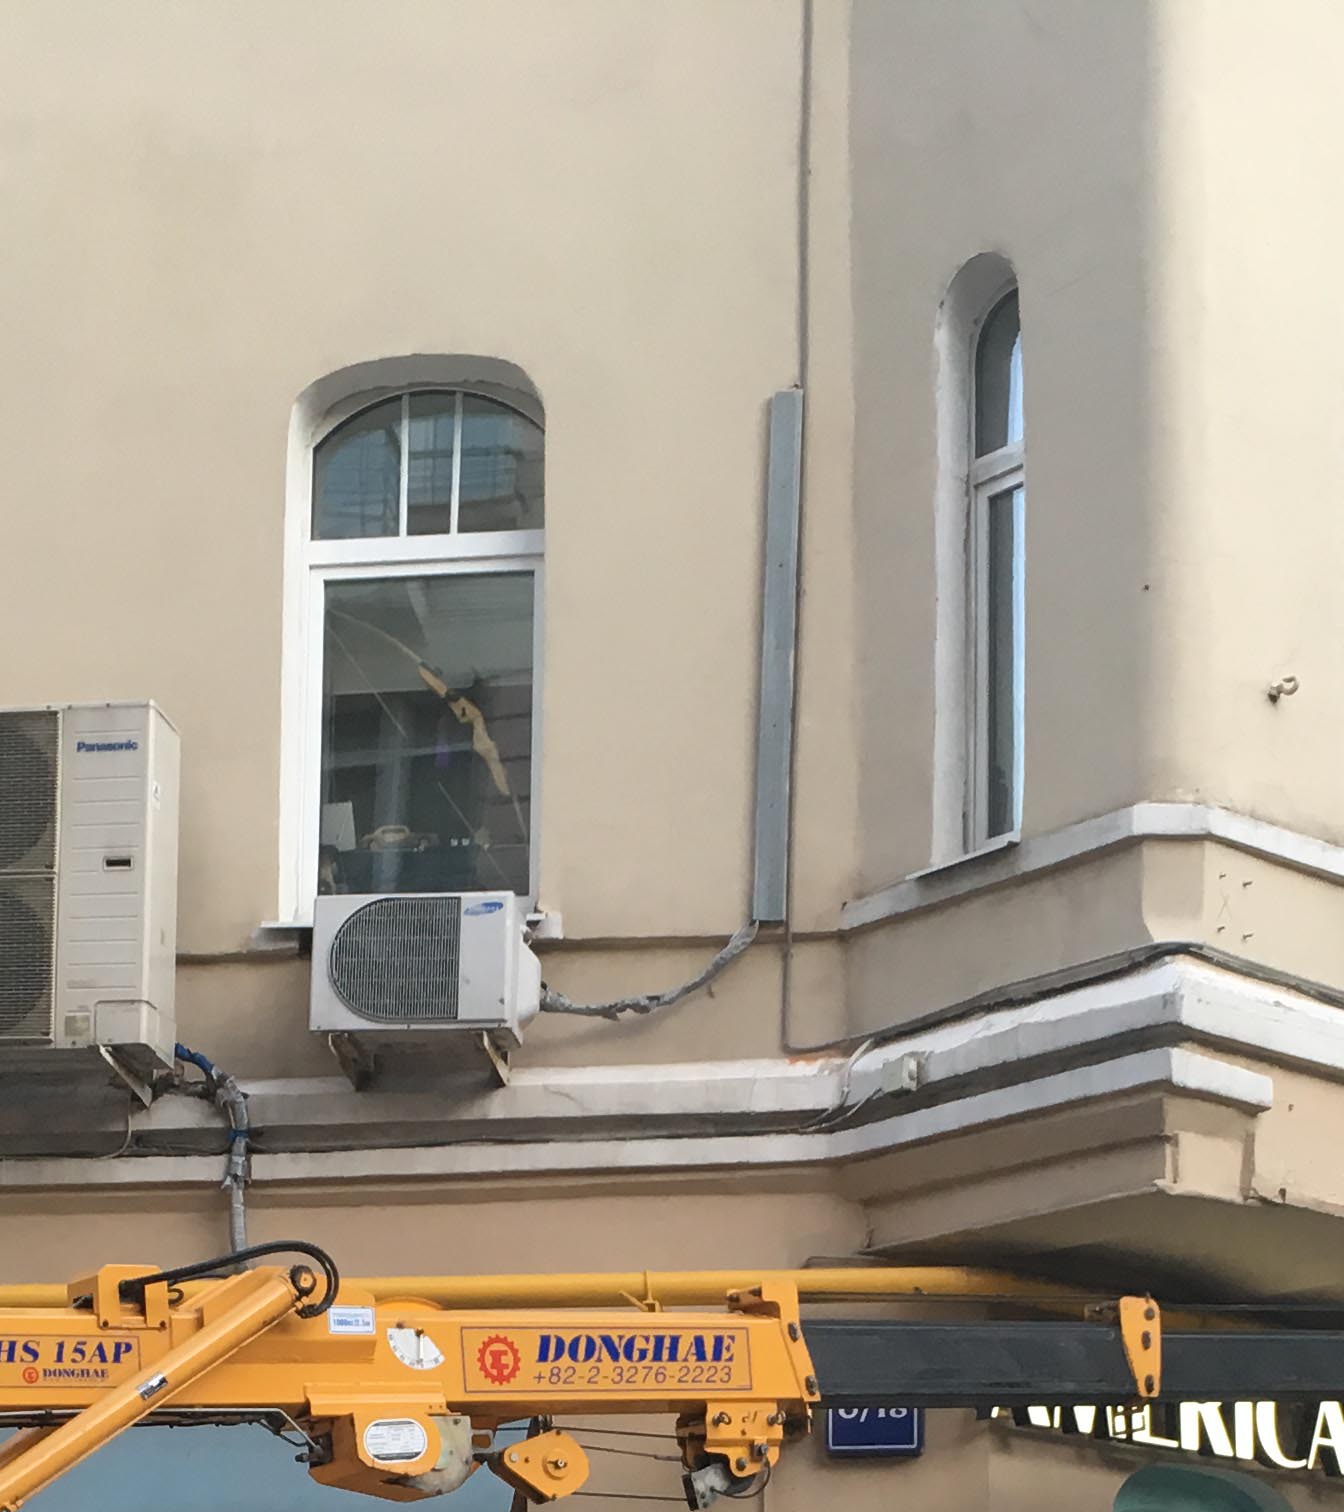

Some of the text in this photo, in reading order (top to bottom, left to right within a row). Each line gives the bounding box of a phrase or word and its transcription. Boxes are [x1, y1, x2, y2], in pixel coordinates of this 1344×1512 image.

[76, 740, 138, 752] Panasonic
[54, 1340, 133, 1364] 15AP
[535, 1334, 736, 1363] DONGHAE
[42, 1368, 109, 1379] DONGHAE
[532, 1365, 733, 1385] +82-2-3276-2223
